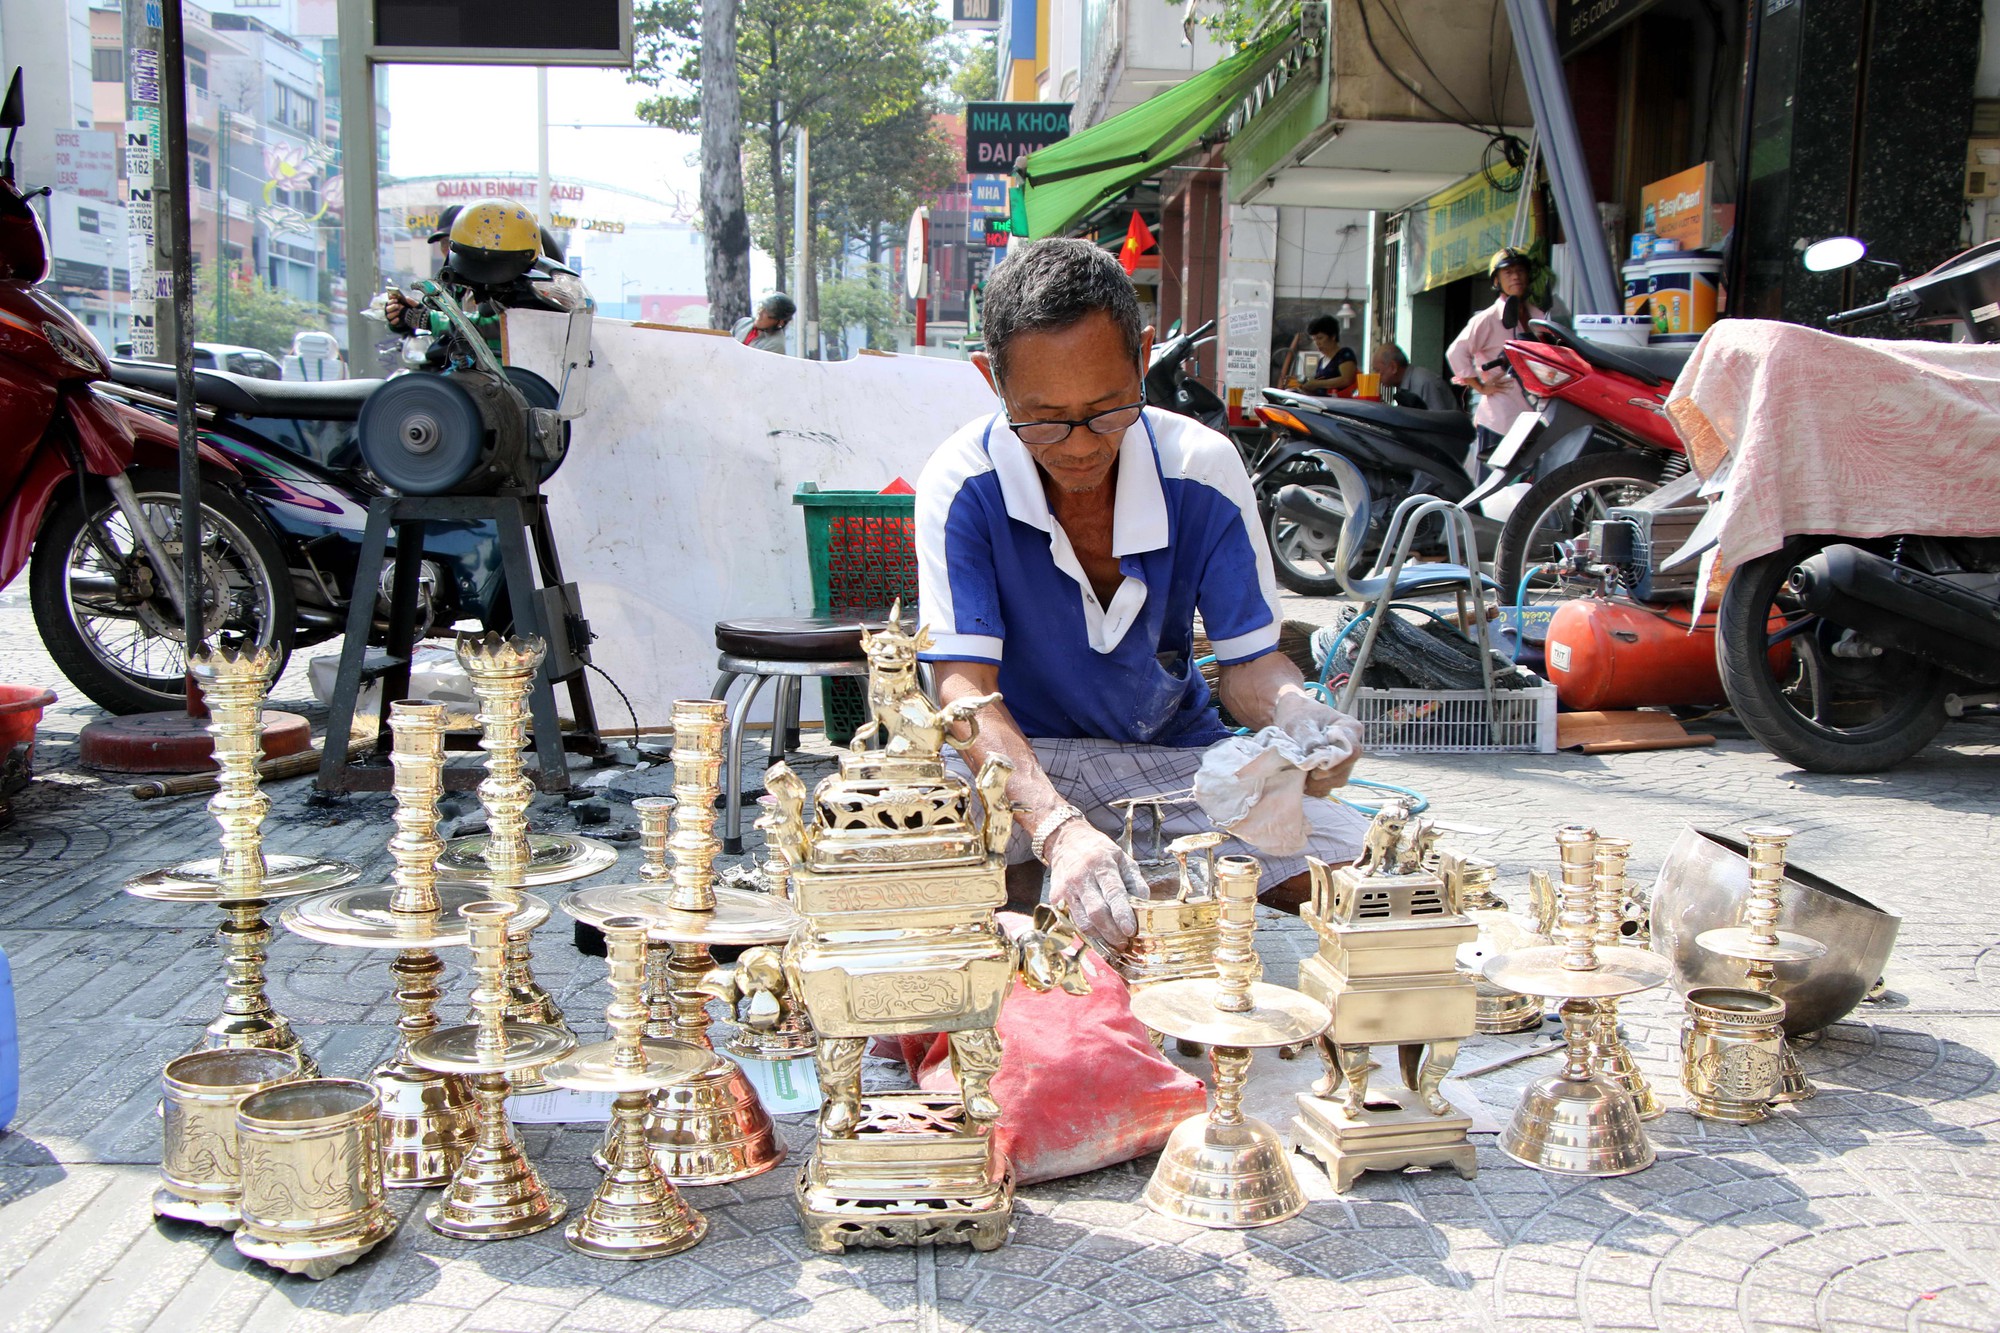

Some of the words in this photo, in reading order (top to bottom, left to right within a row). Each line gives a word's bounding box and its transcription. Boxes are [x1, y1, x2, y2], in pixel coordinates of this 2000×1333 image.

[973, 112, 1012, 131] NHA
[1017, 113, 1069, 132] KHOA
[56, 134, 80, 147] OFFICE
[56, 153, 71, 165] FOR
[978, 143, 1012, 165] ĐẠI
[58, 172, 78, 184] LEASE
[526, 182, 584, 201] TẠNH
[977, 187, 1000, 200] NHA
